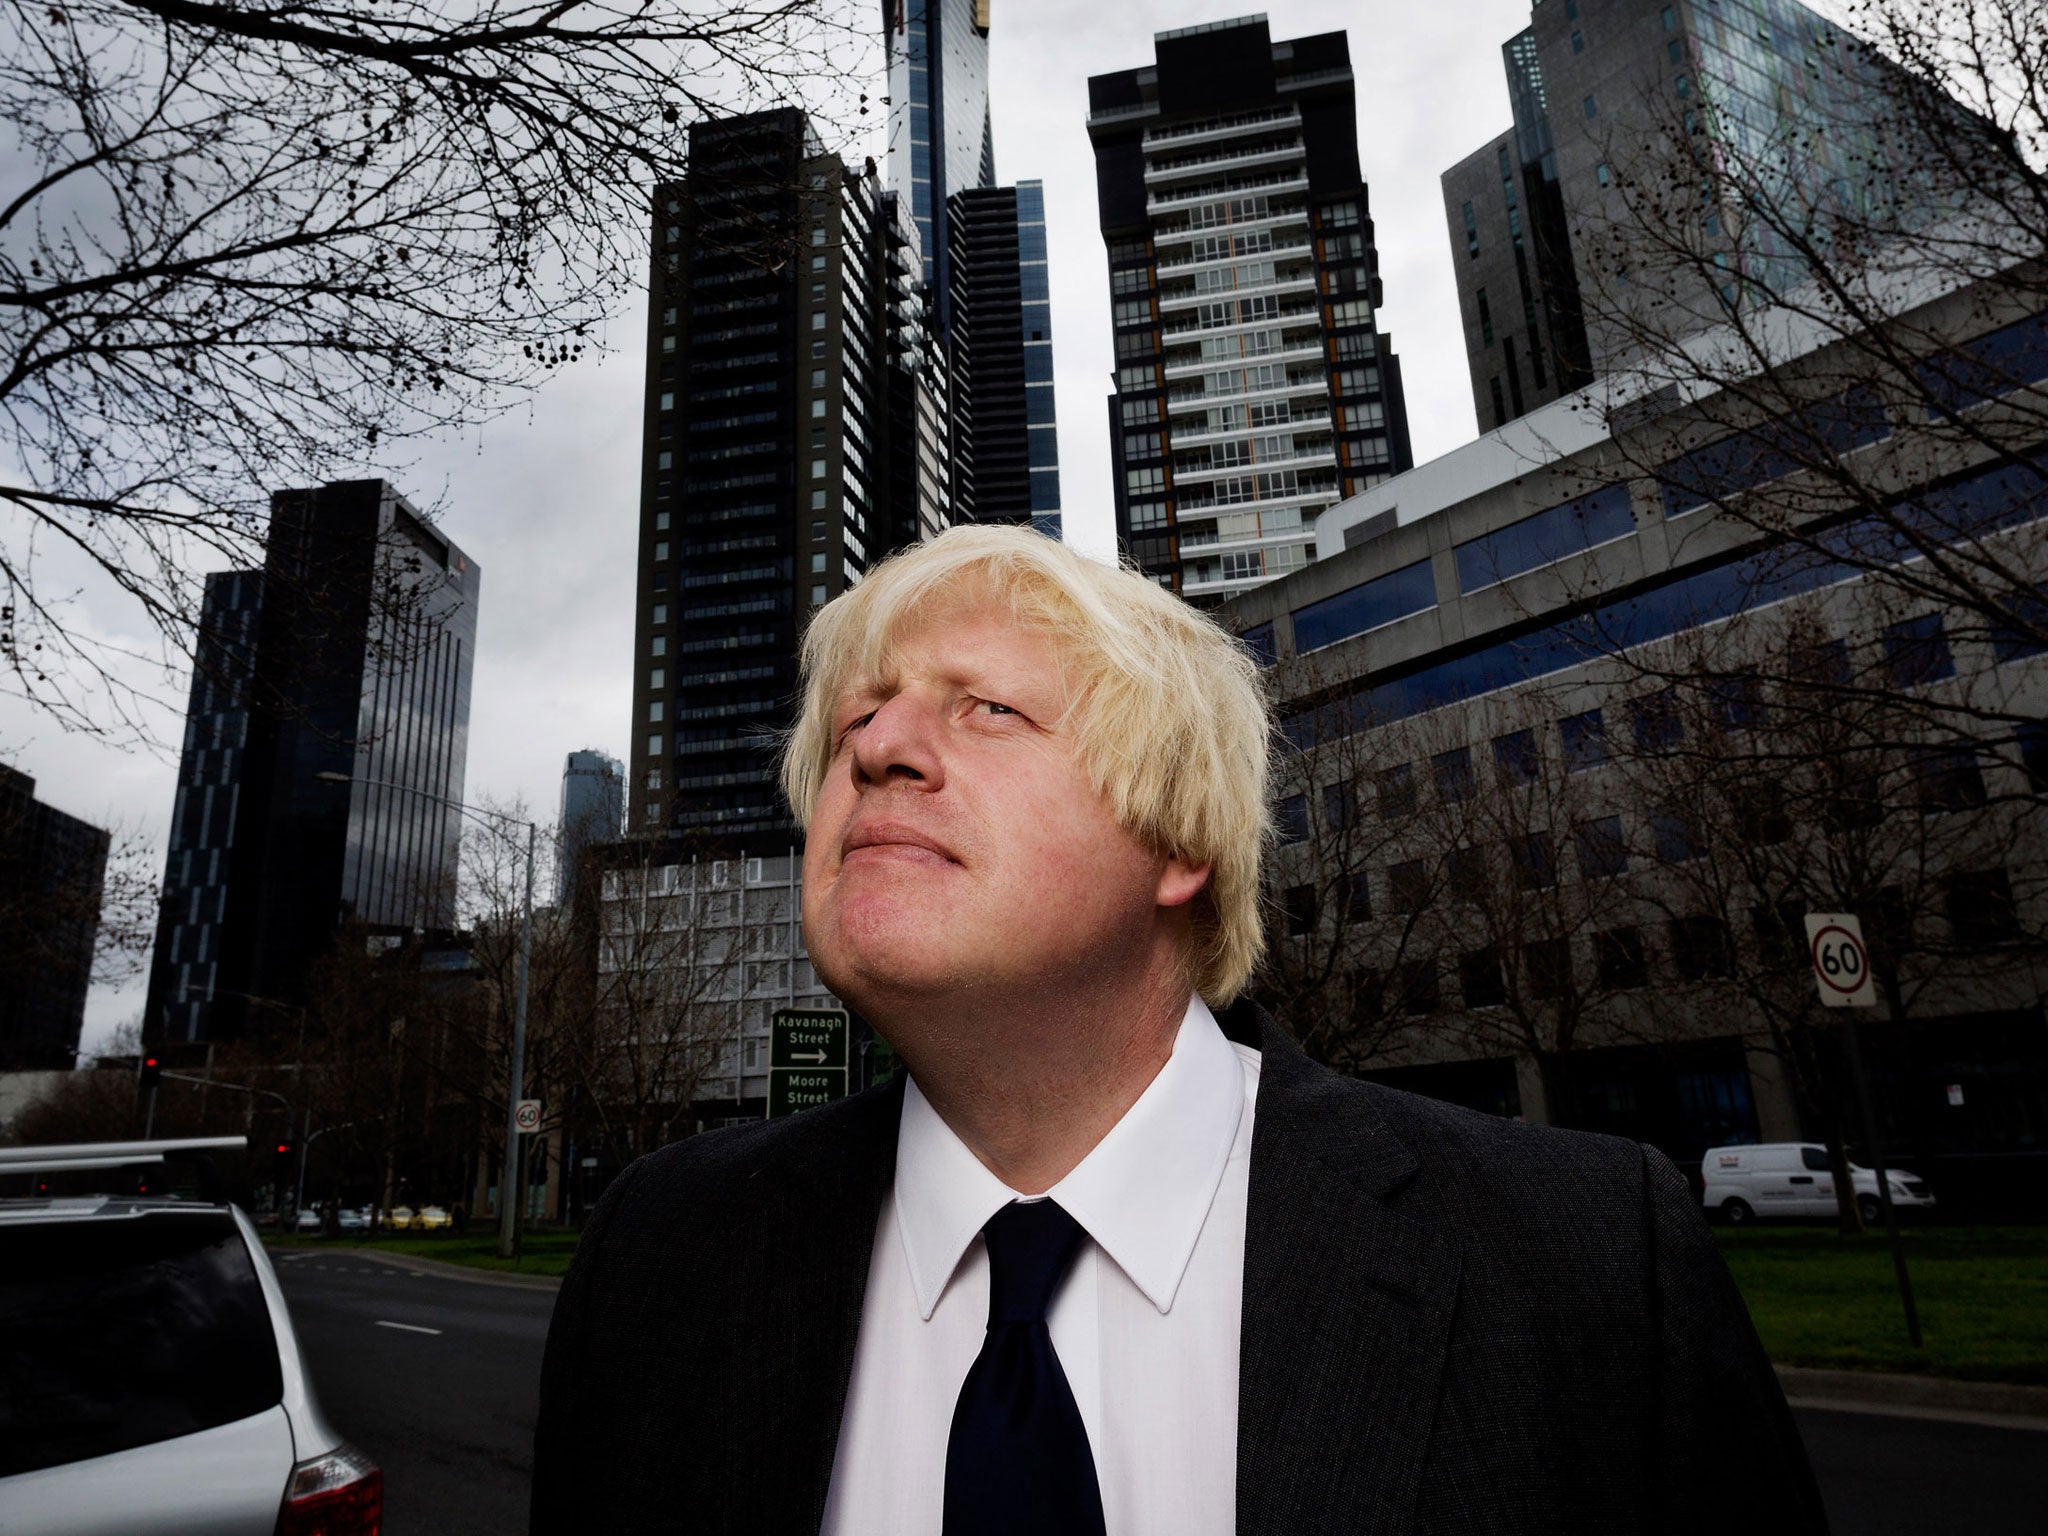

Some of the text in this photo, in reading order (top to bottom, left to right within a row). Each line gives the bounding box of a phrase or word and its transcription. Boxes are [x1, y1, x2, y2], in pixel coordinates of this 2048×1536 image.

[1823, 943, 1859, 975] 60
[778, 1015, 842, 1031] Kavanagh
[789, 1032, 830, 1044] Street
[788, 1075, 829, 1087] Moore
[787, 1091, 829, 1104] Street
[520, 1110, 536, 1122] 60
